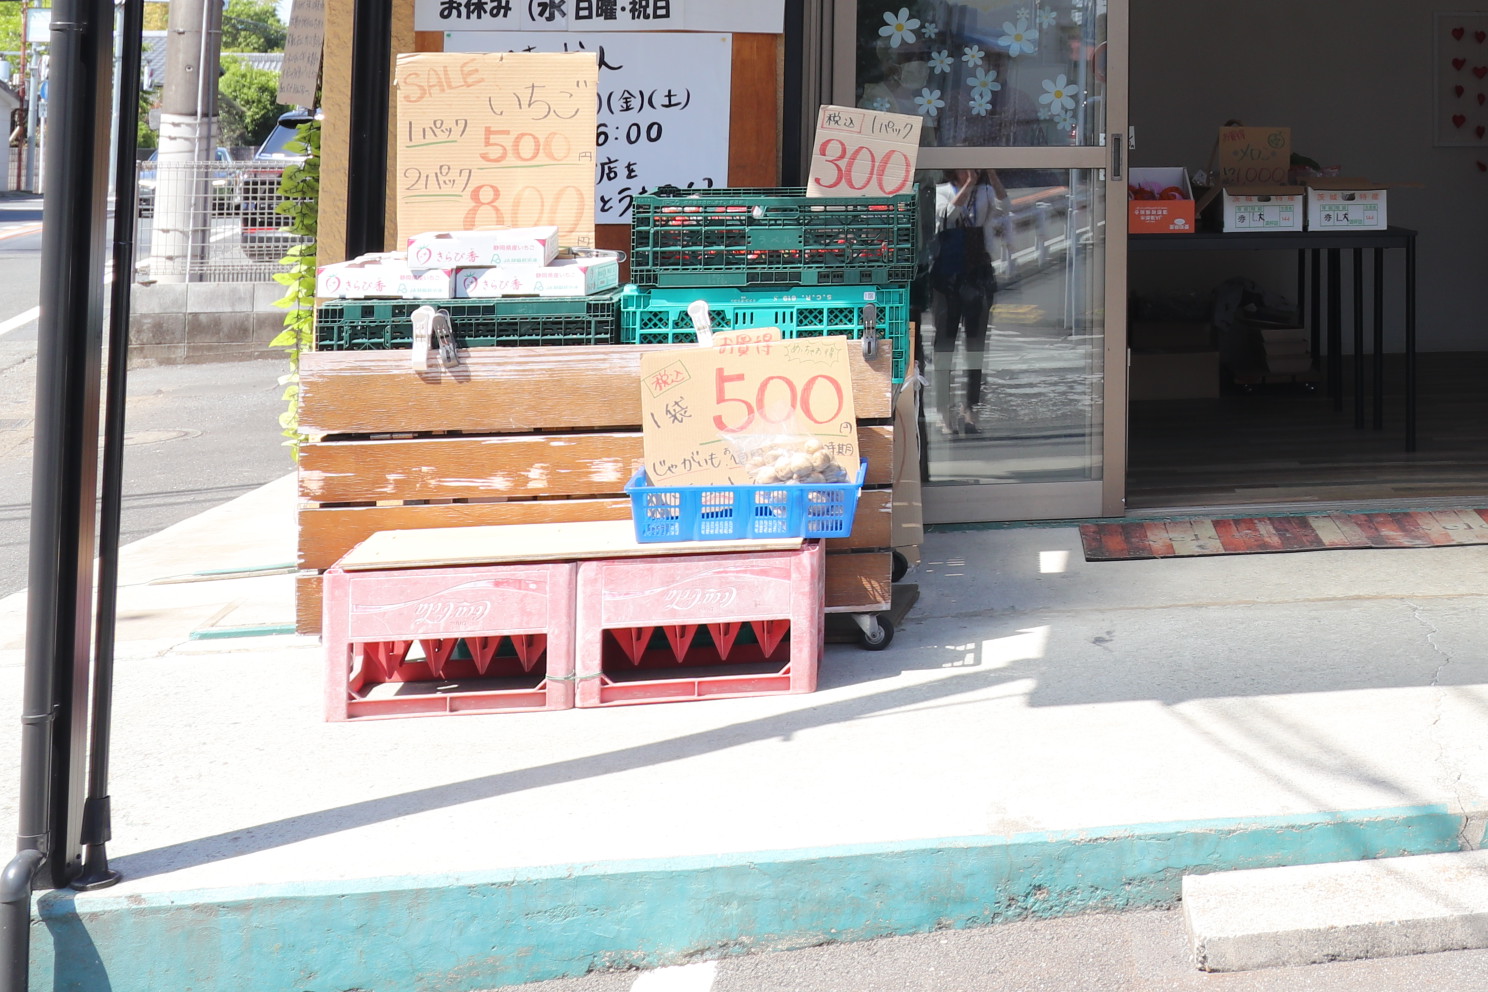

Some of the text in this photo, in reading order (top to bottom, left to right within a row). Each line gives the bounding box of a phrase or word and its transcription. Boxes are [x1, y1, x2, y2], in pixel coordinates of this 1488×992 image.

[403, 58, 486, 103] SALE
[488, 80, 588, 120] いちご
[826, 112, 855, 128] 税込
[814, 138, 912, 196] 300
[718, 333, 773, 356] お買得
[651, 369, 685, 392] 税込
